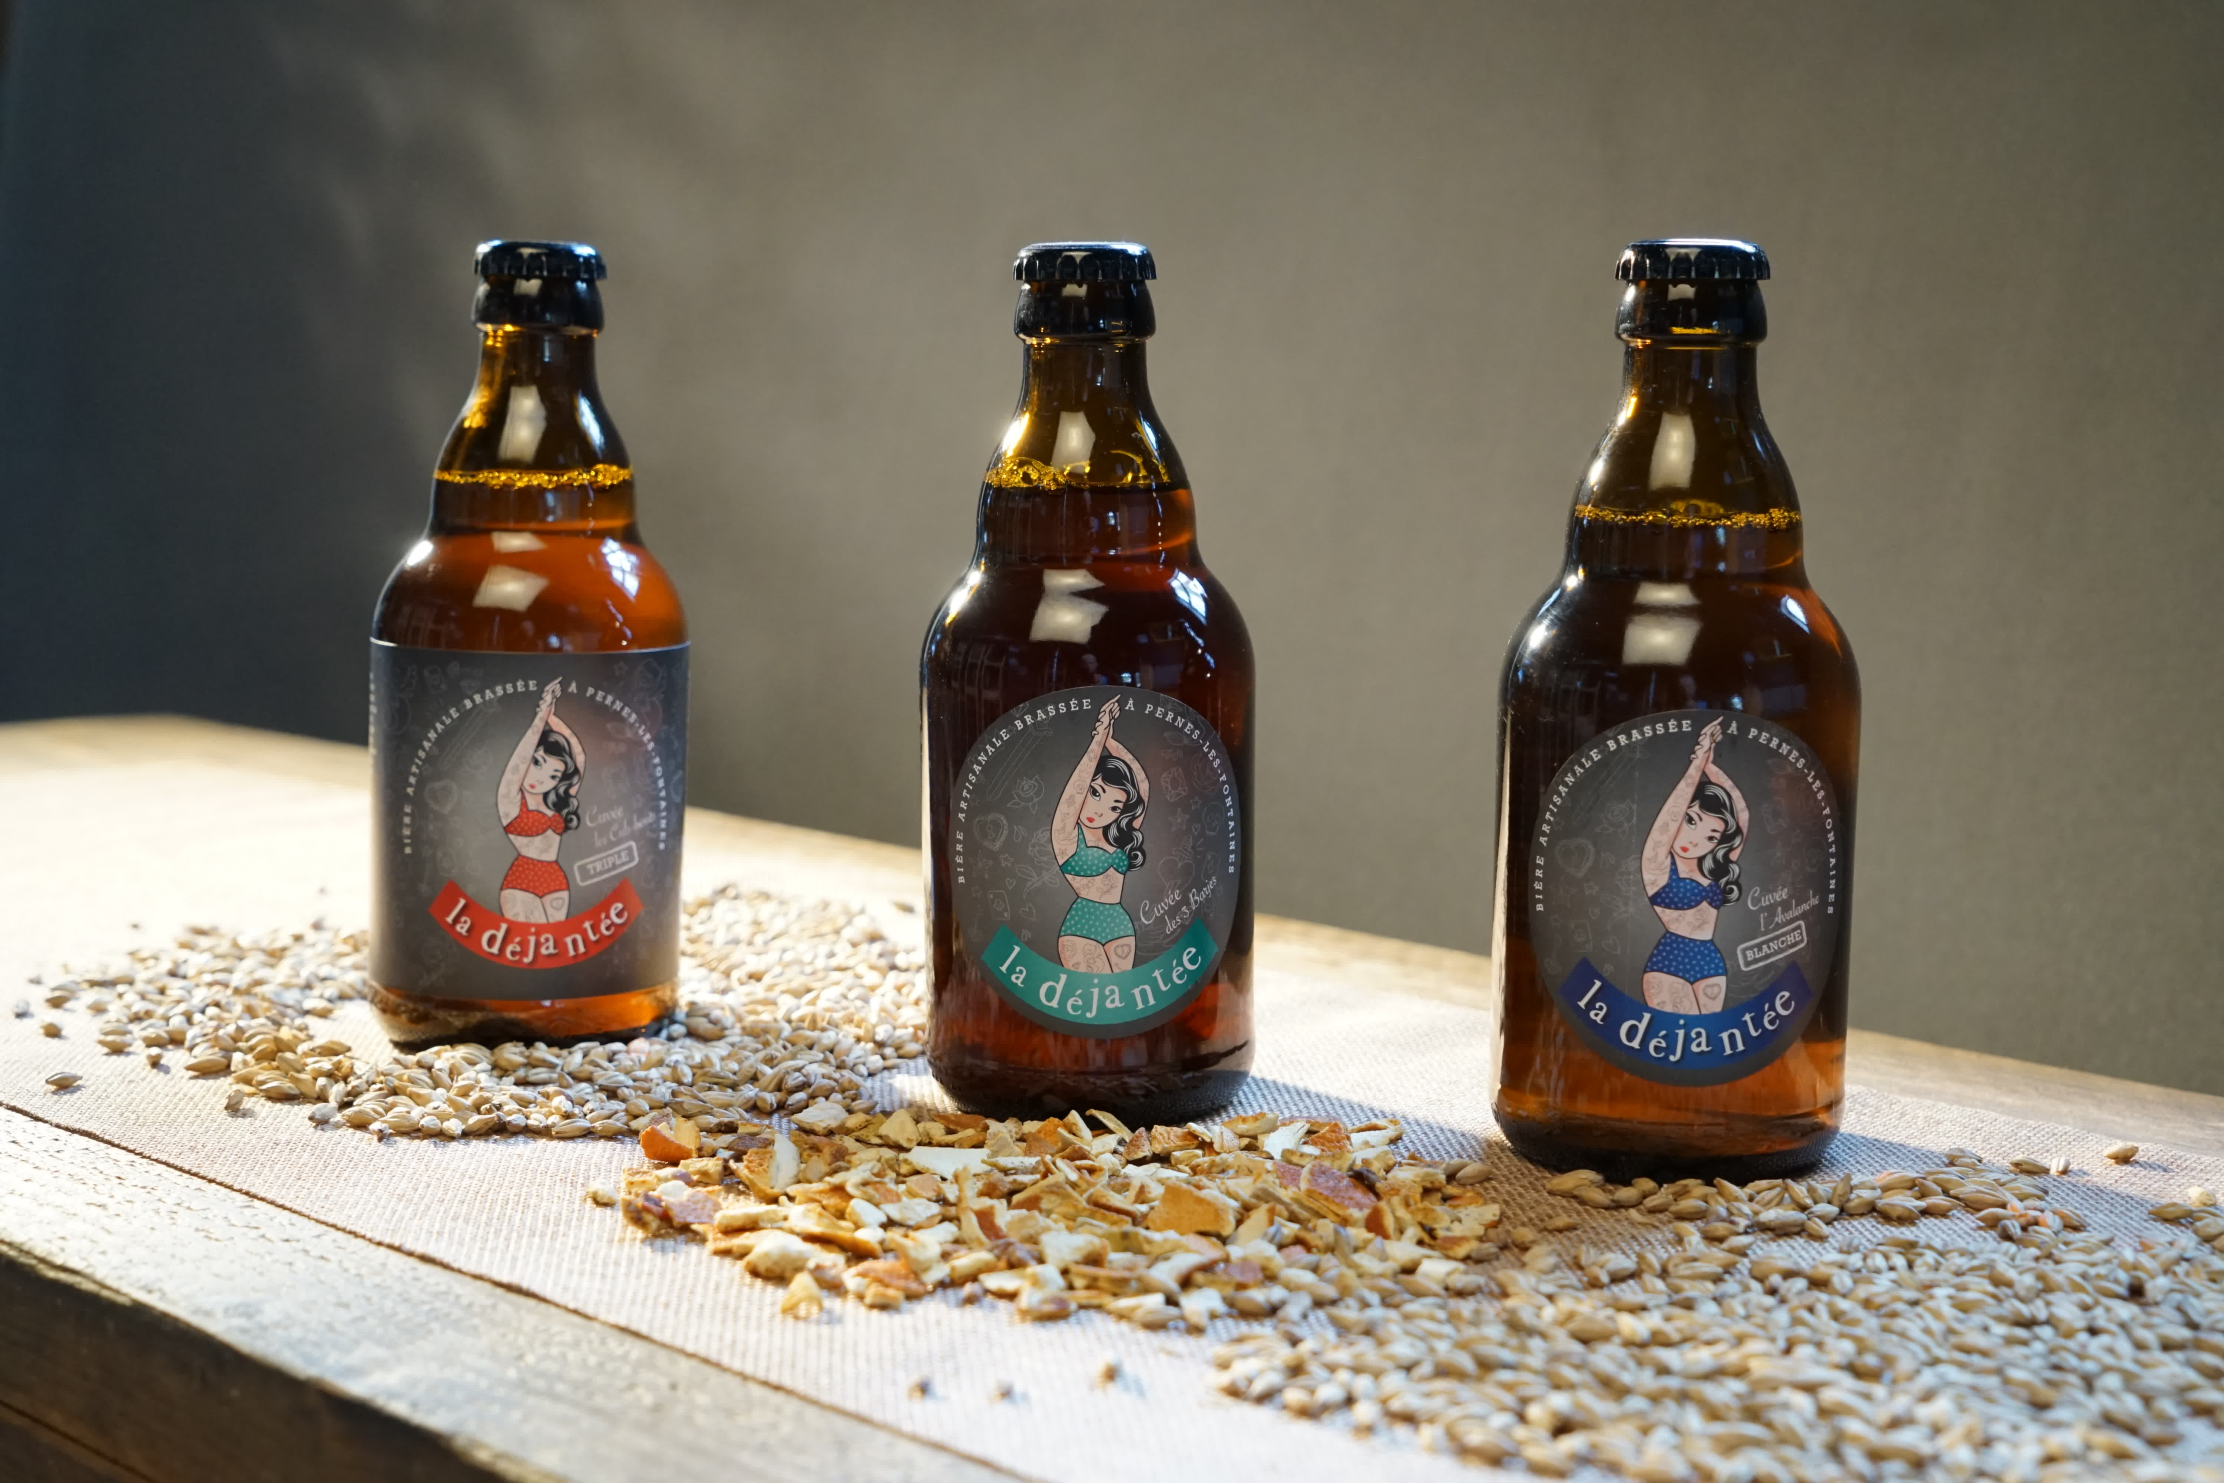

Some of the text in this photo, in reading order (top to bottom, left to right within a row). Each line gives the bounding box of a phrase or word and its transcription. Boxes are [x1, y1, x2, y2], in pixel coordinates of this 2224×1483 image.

[406, 707, 460, 796] ARTISANALE
[465, 679, 538, 710] BRASSÉE
[568, 680, 578, 694] À
[955, 698, 1236, 883] BIÈRE ARTISANALE BRASSÉE À PERNES-LES-FONTAINES
[1535, 719, 1837, 915] BIÈRE ARTISANALE BRASSÉE À PERNES-LES-FONTAINES
[586, 850, 630, 875] TRIPLE
[444, 898, 628, 964] la déjantée
[1140, 889, 1182, 925] Cuvée
[1165, 876, 1217, 934] des 3 Barjes
[1747, 887, 1788, 911] Cuvée
[1745, 930, 1802, 961] BLANCHE
[999, 946, 1201, 1018] la déjantée
[1577, 979, 1795, 1062] la déjantée
